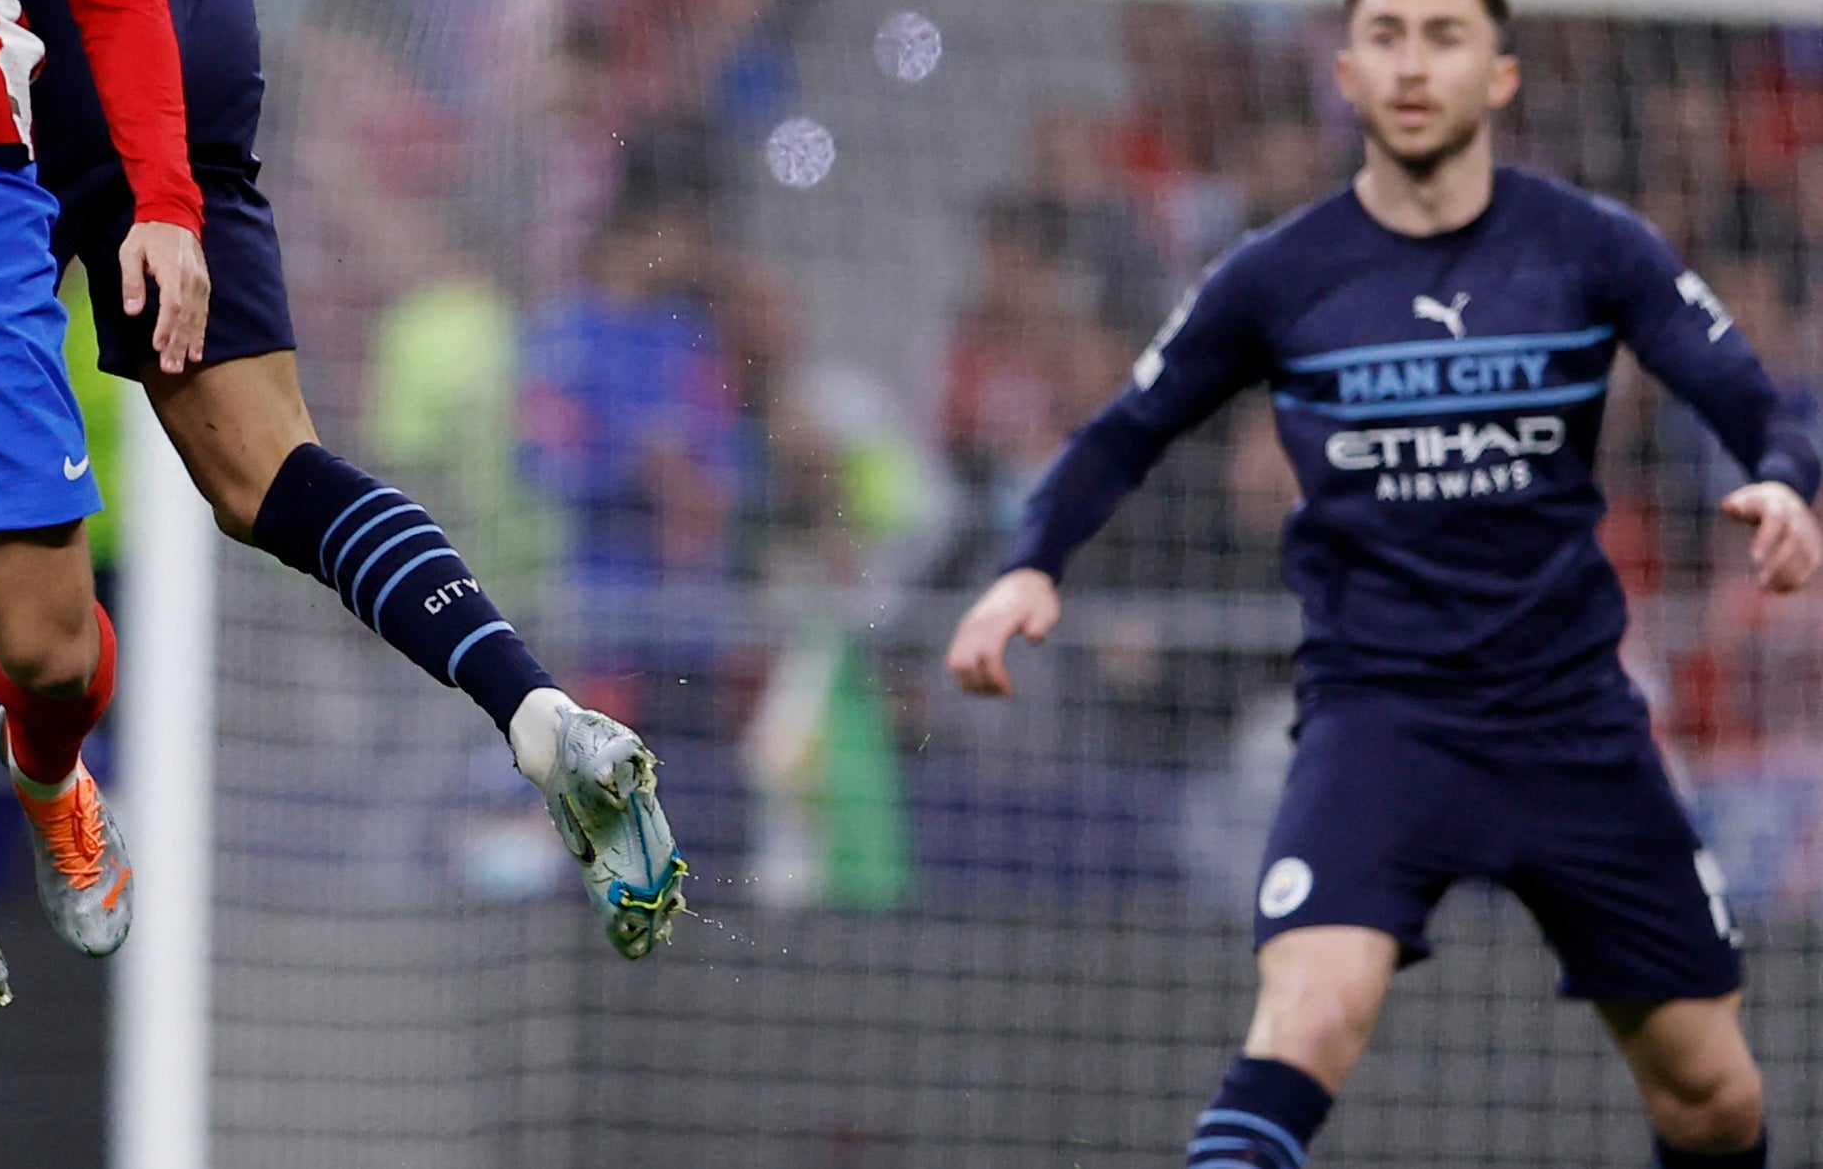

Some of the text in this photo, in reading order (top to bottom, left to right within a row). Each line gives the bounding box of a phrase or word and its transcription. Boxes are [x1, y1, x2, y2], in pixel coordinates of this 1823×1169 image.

[1338, 352, 1550, 404] MAN CITY
[1325, 415, 1567, 471] ETIHAD
[1376, 459, 1532, 502] AIRWAYS
[424, 578, 480, 615] CITY
